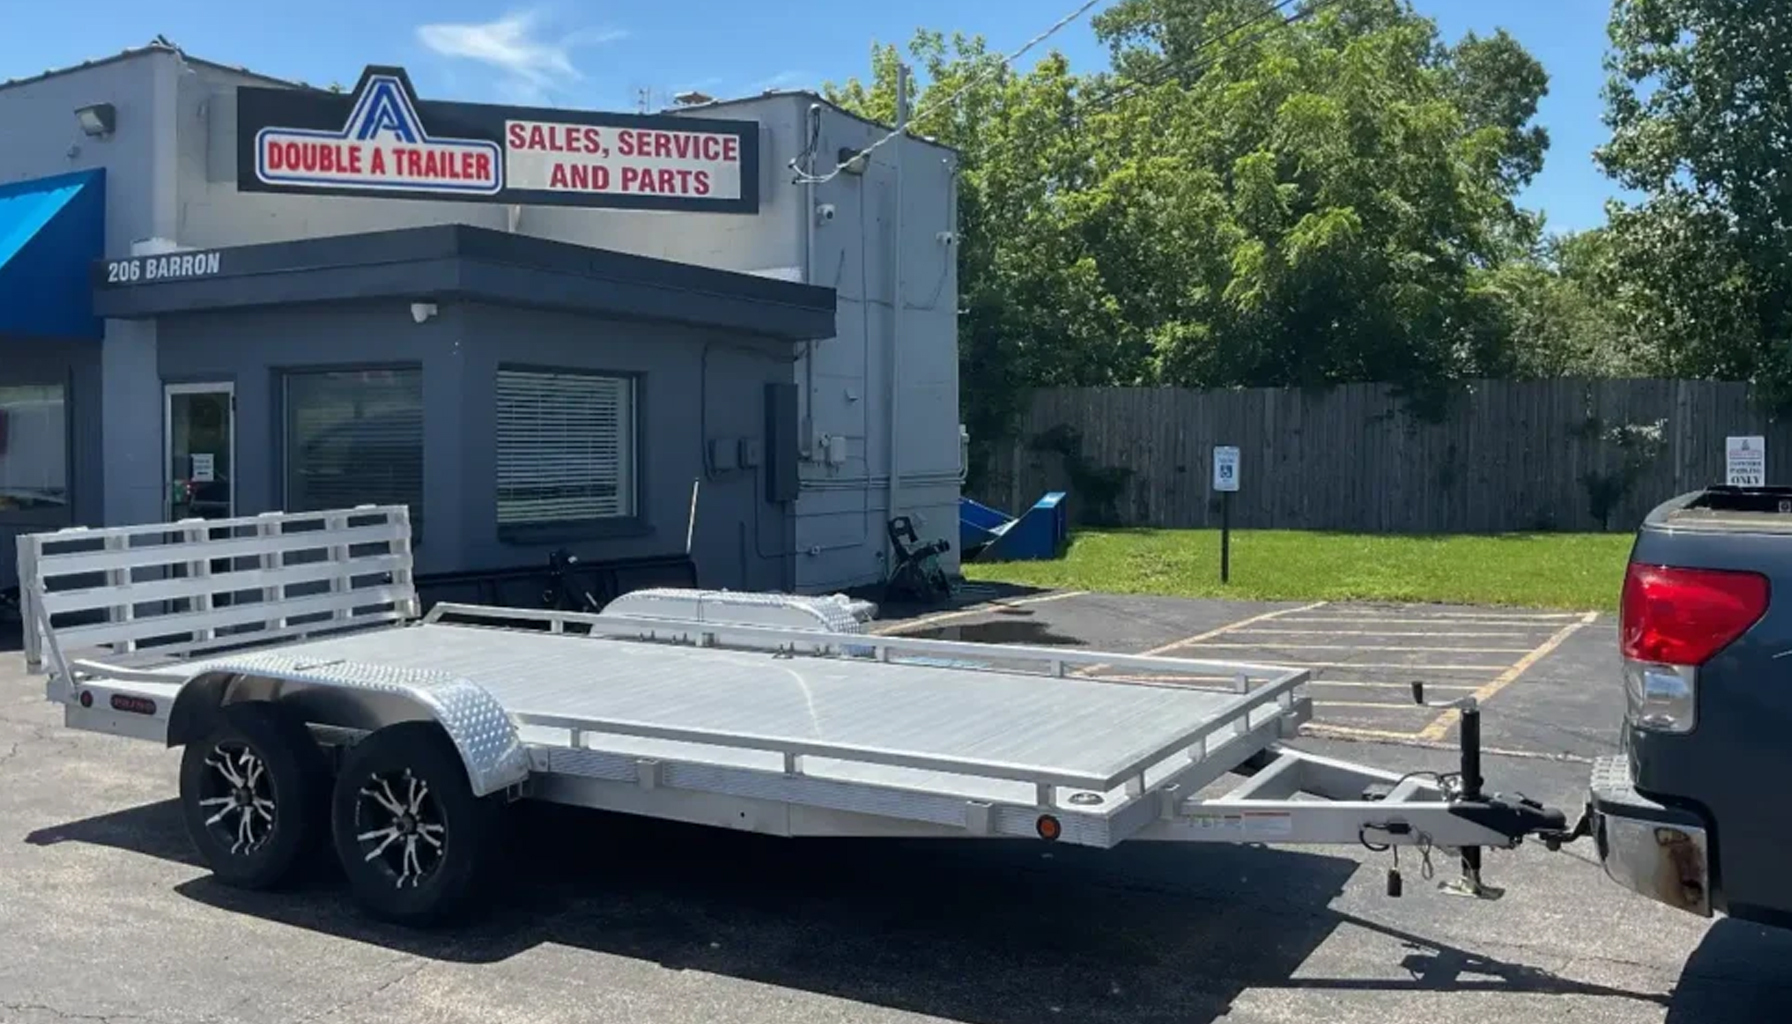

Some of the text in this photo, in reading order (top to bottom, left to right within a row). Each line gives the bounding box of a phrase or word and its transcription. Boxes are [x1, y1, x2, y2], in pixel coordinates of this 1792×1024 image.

[508, 123, 738, 162] SALES, SERVICE
[267, 142, 491, 181] DOUBLE A TRAILER
[550, 163, 710, 196] AND PARTS
[107, 252, 220, 283] 206 BARRON
[1730, 475, 1760, 485] ONLY
